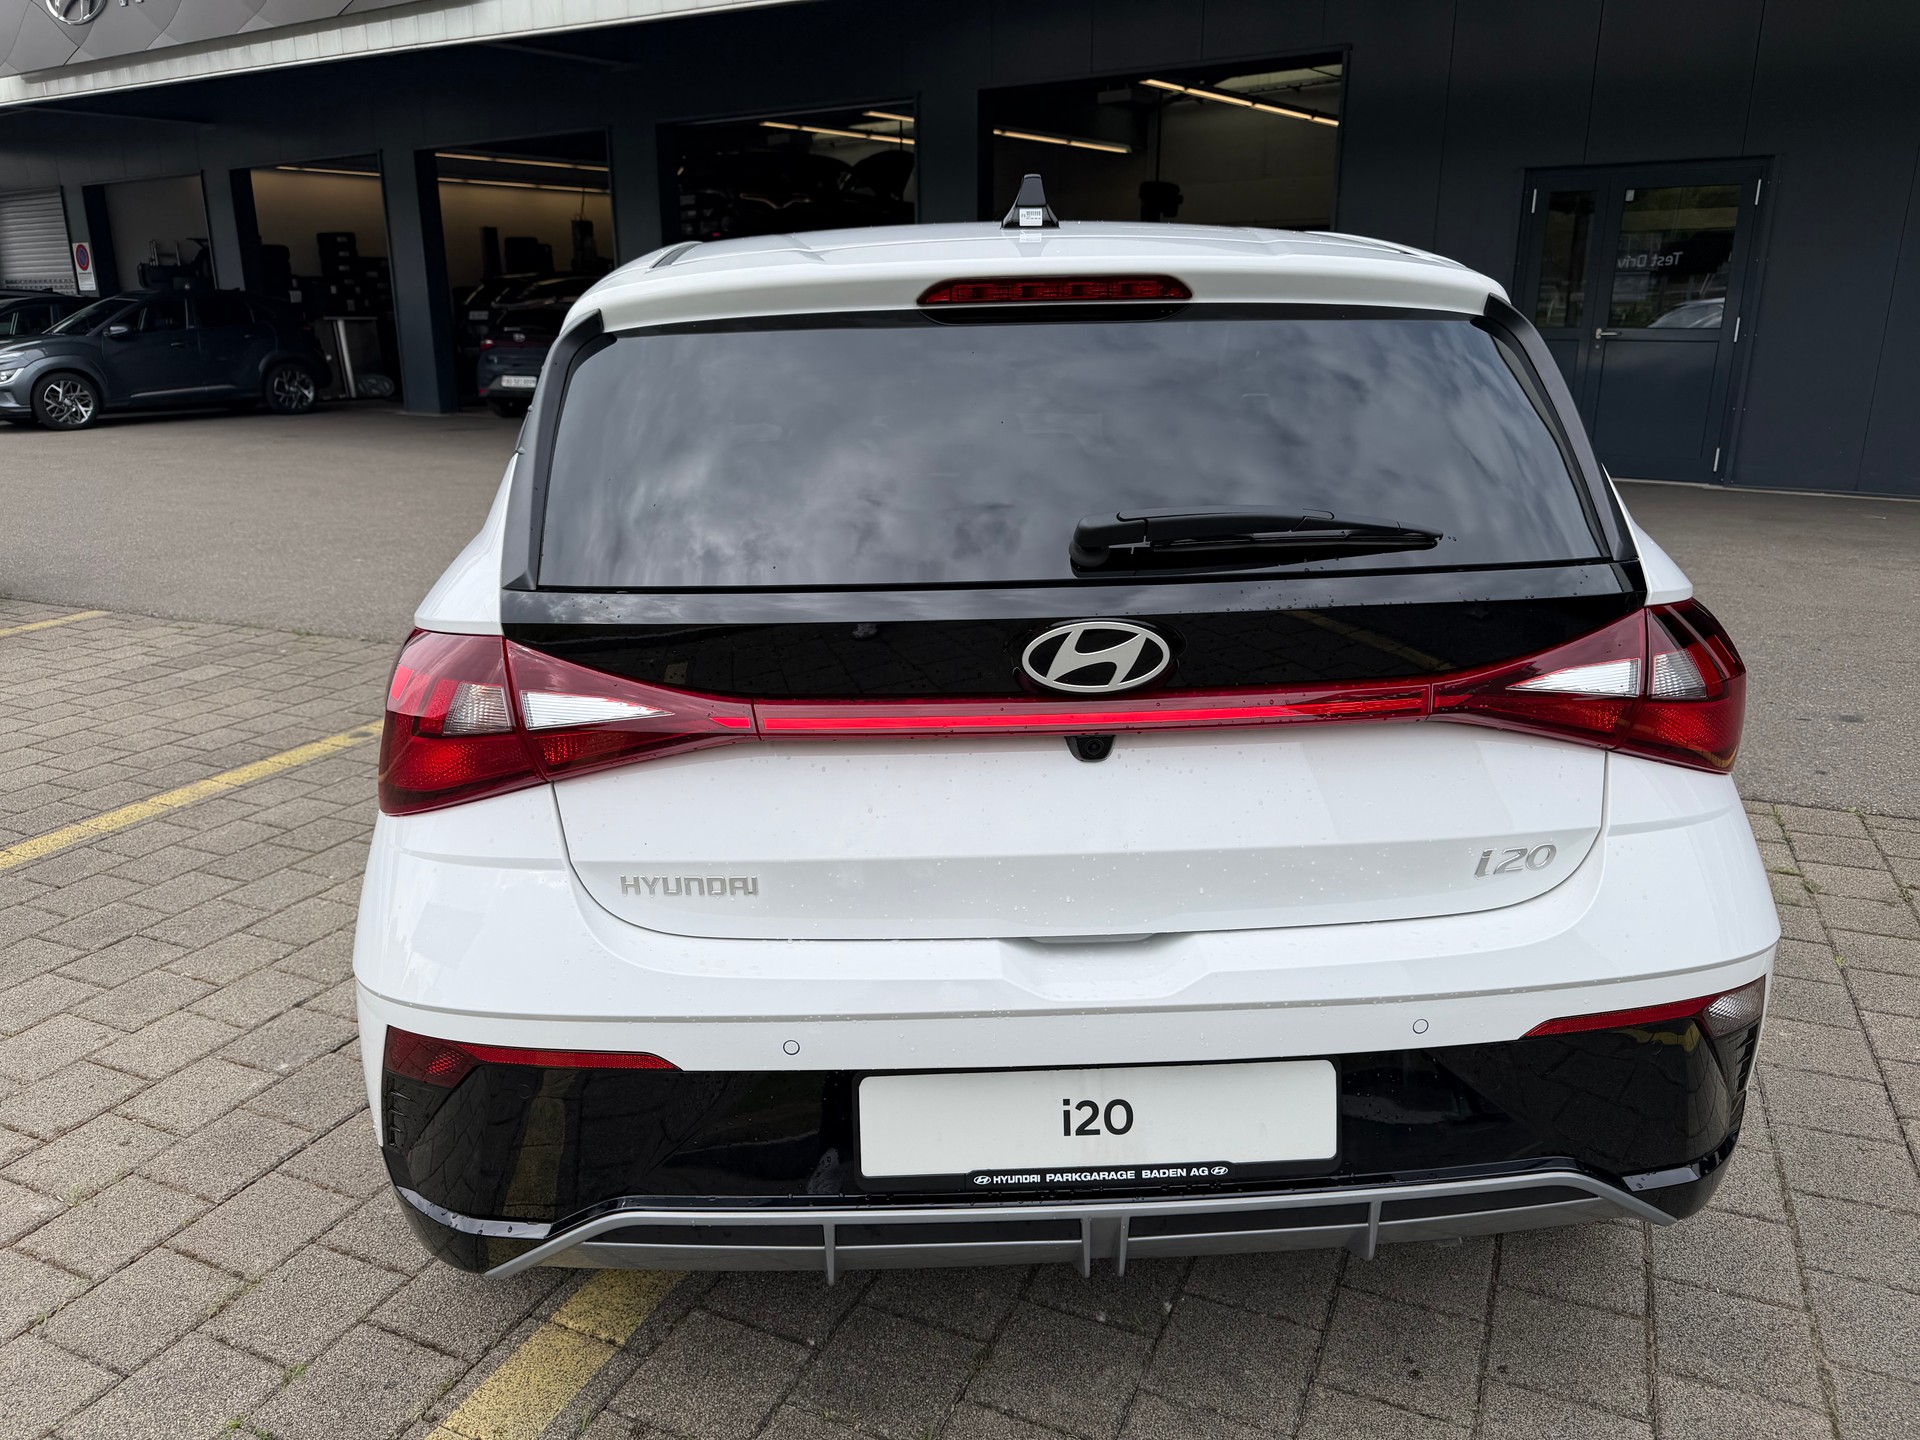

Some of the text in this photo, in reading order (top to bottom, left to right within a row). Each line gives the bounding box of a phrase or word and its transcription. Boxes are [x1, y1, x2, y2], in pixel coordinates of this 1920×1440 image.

[1474, 843, 1556, 879] i20
[620, 875, 759, 896] HYUNDAI
[1062, 1098, 1134, 1136] i20
[993, 1167, 1209, 1184] HYUNDAI PARKGARAGE BADEN AG
